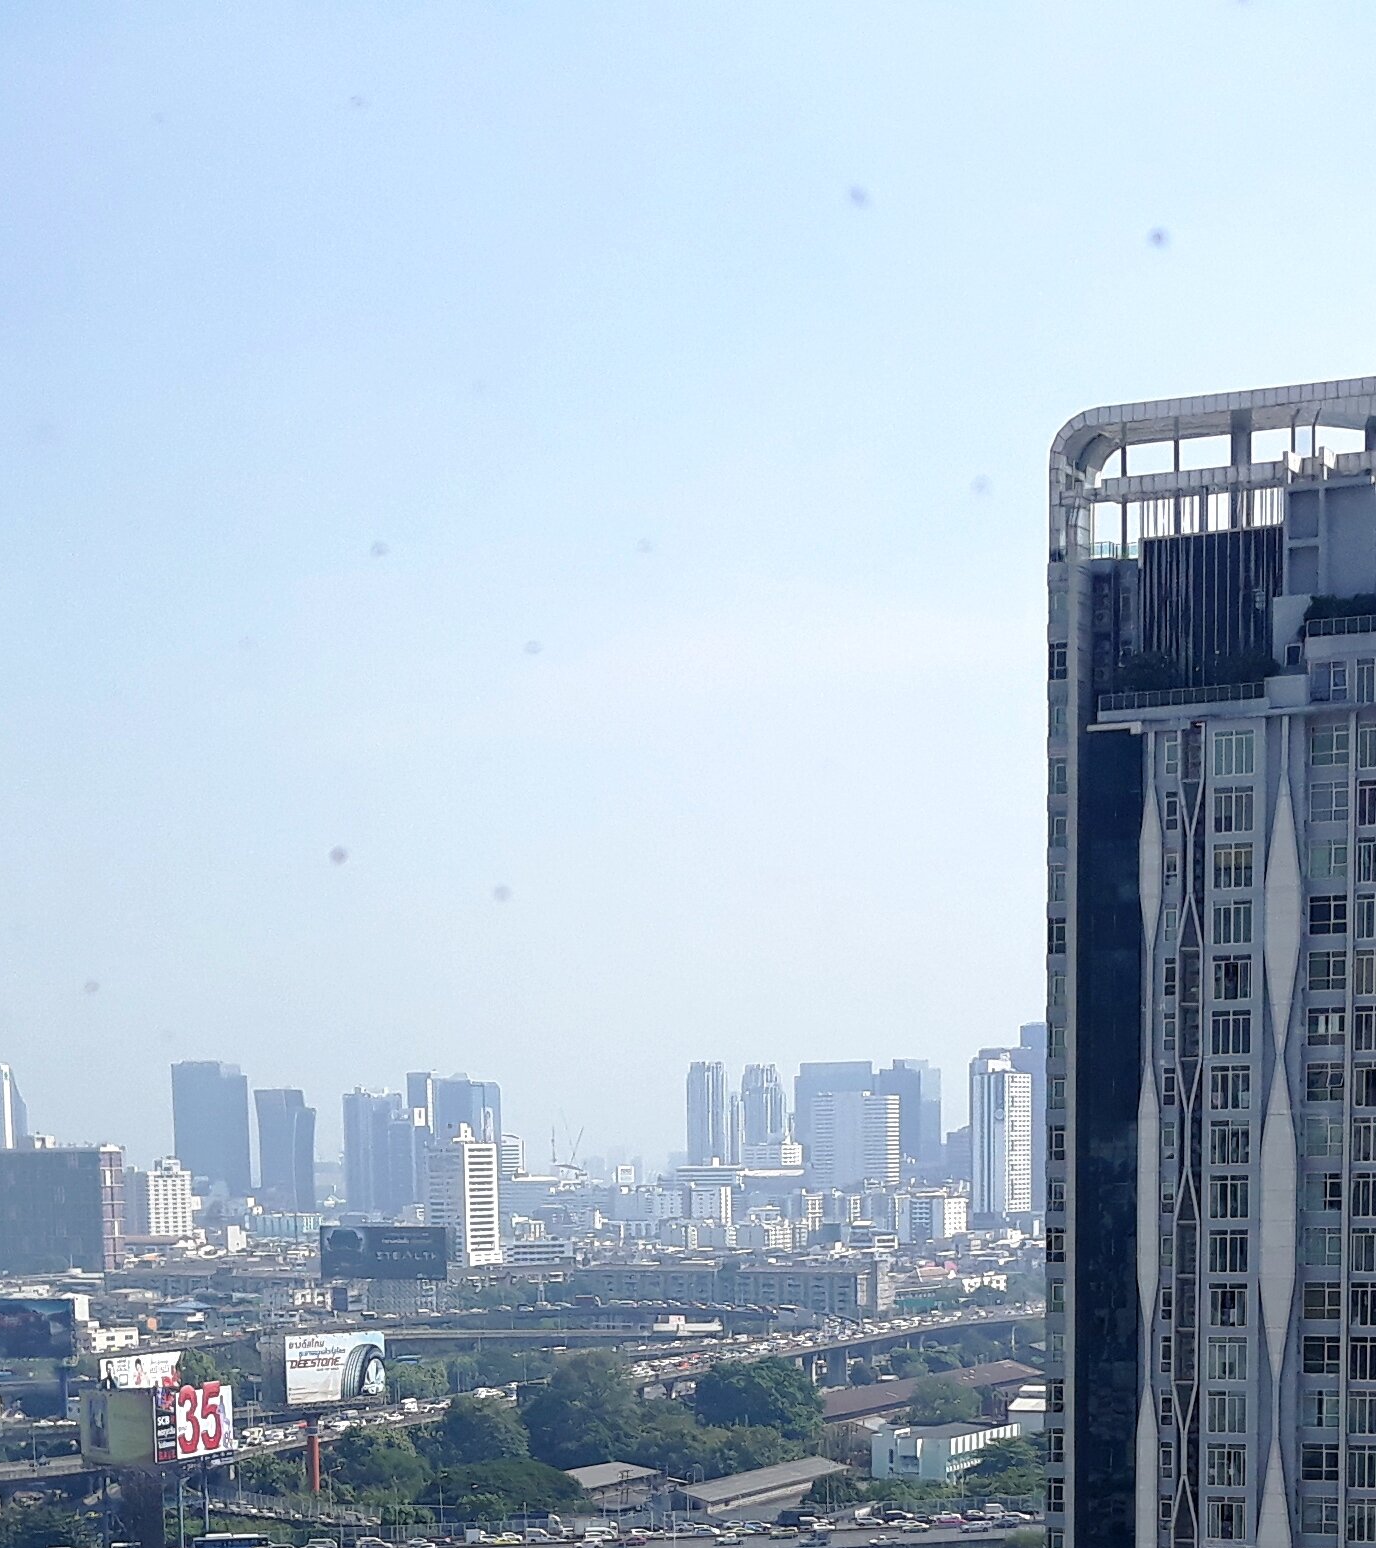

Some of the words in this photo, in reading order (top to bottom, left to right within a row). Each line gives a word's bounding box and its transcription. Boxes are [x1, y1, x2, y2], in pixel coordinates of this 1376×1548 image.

[290, 1357, 341, 1369] DEESTONE
[157, 1416, 170, 1426] SCB
[178, 1380, 221, 1454] 35
